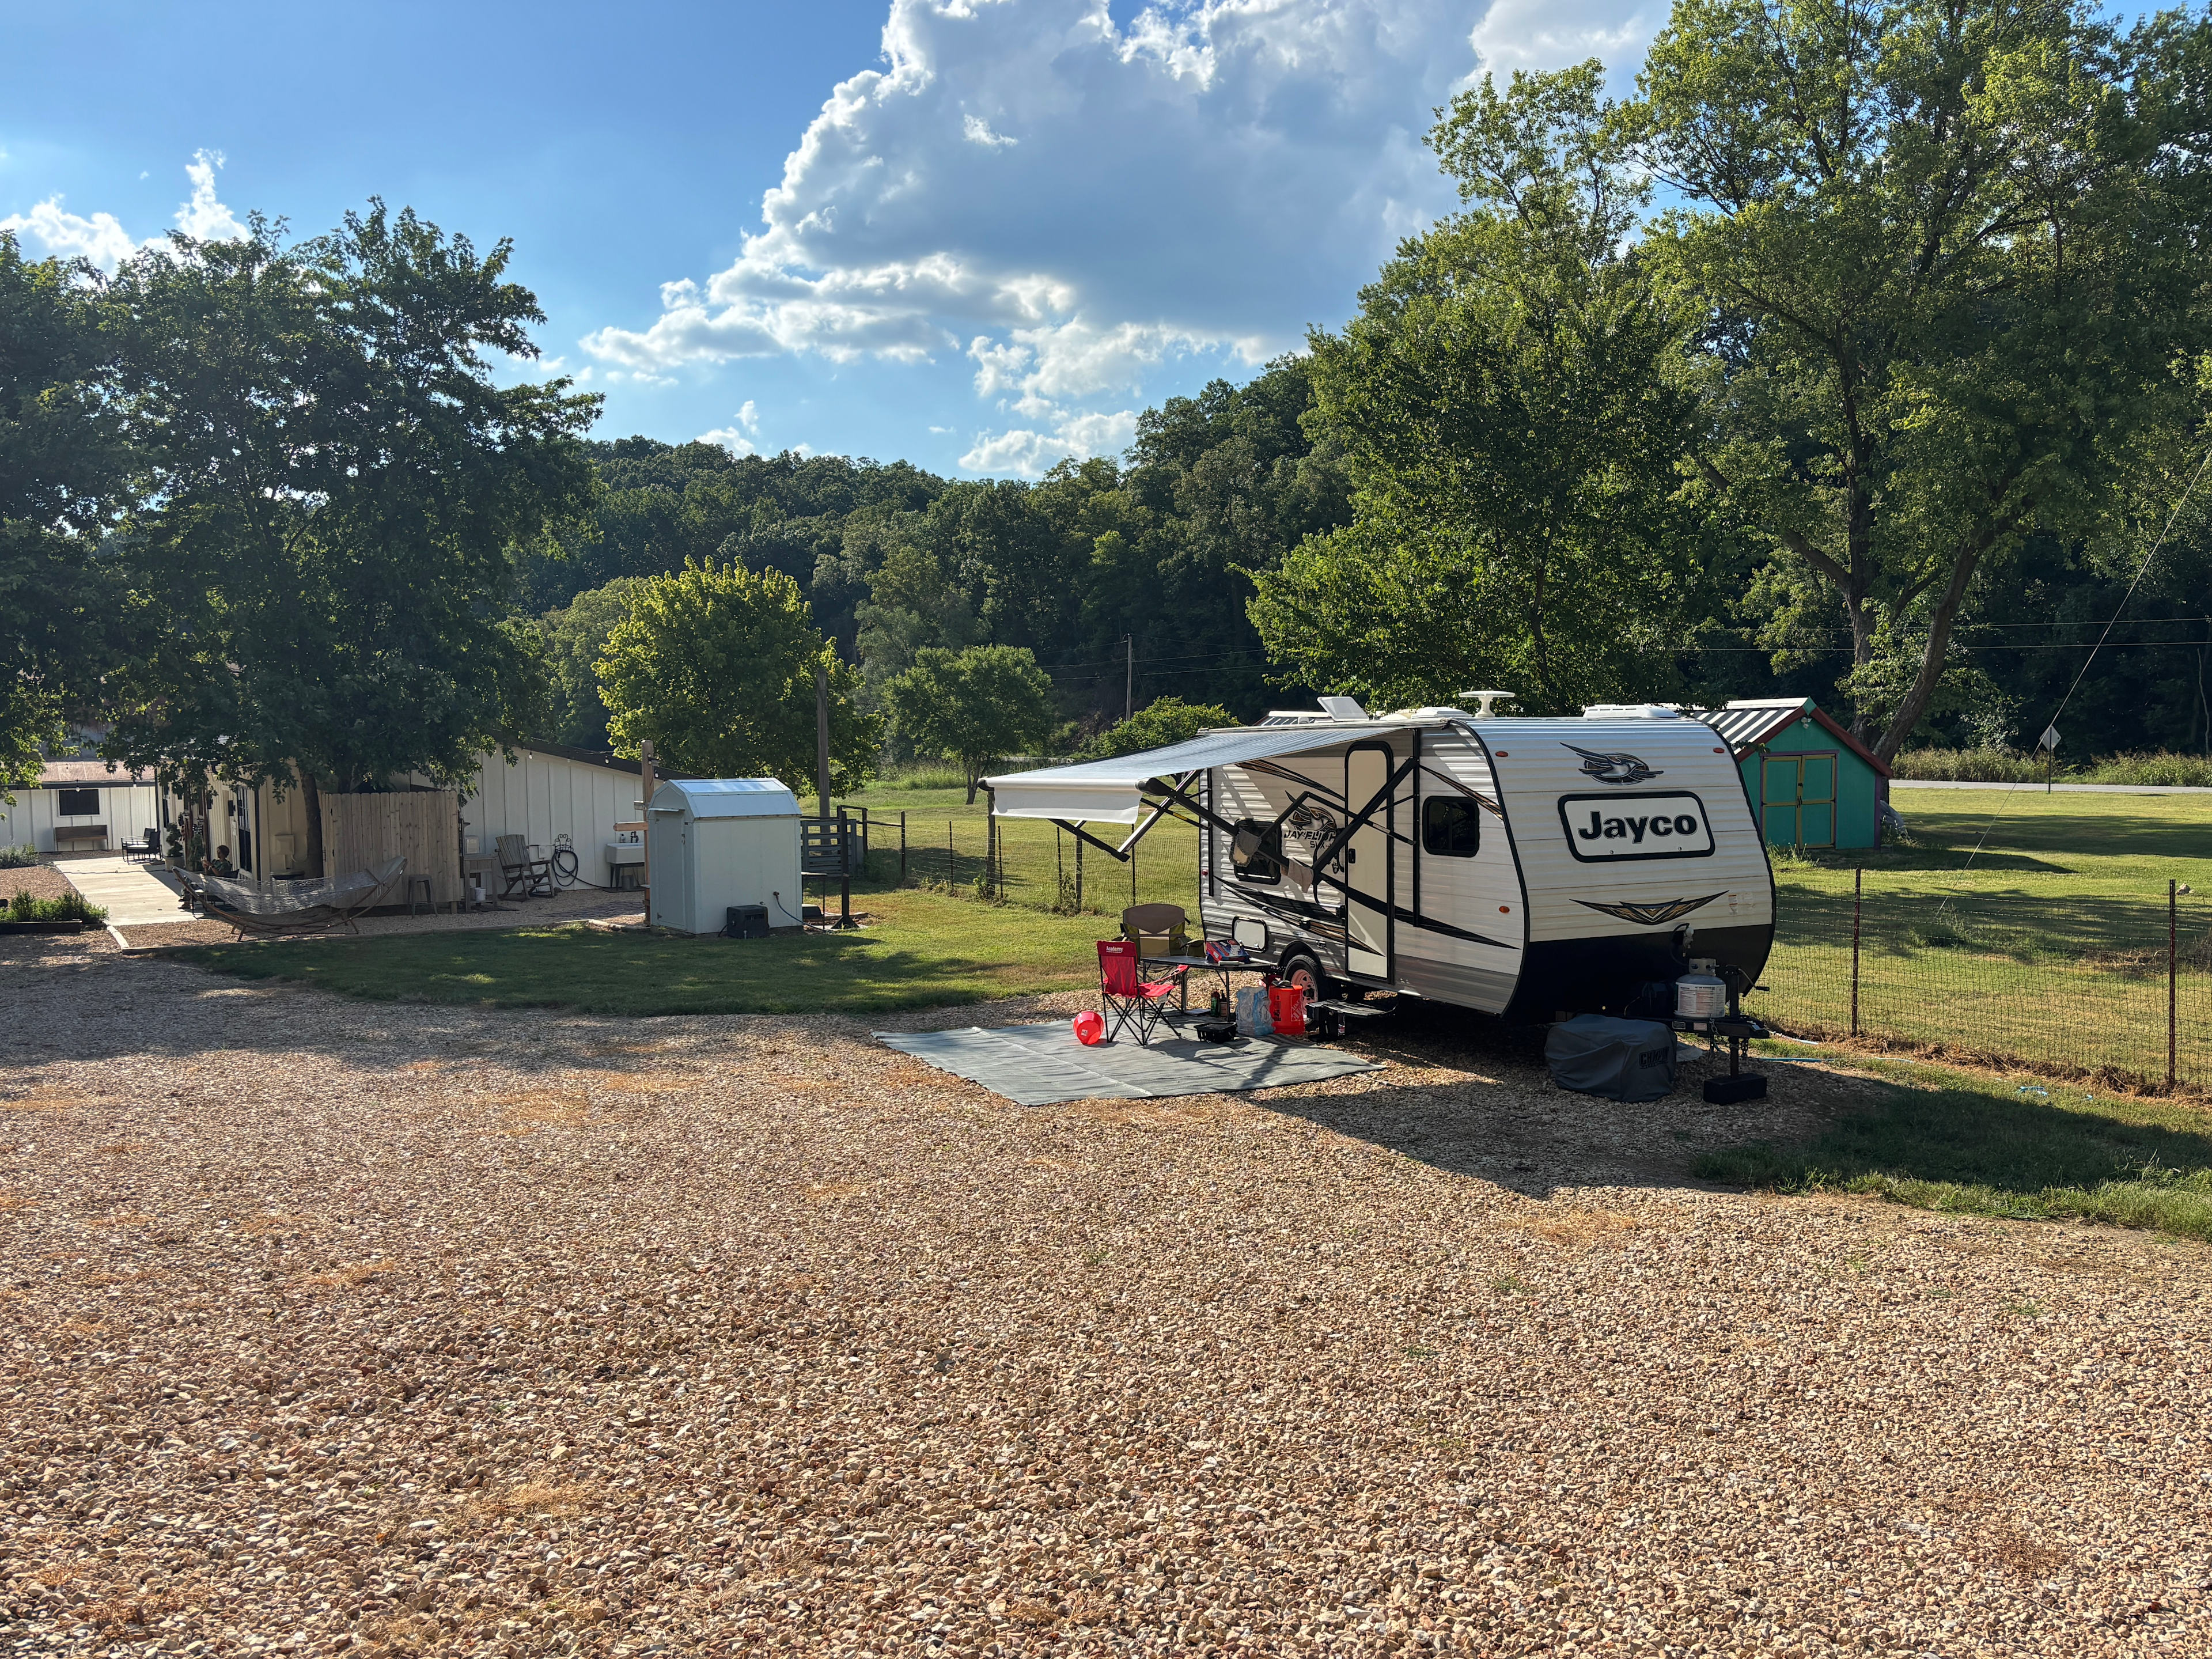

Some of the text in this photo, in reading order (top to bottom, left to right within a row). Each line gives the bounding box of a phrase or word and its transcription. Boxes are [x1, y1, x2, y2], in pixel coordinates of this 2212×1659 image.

[1283, 830, 1336, 842] JAY FLIH
[1577, 810, 1698, 844] Jayco
